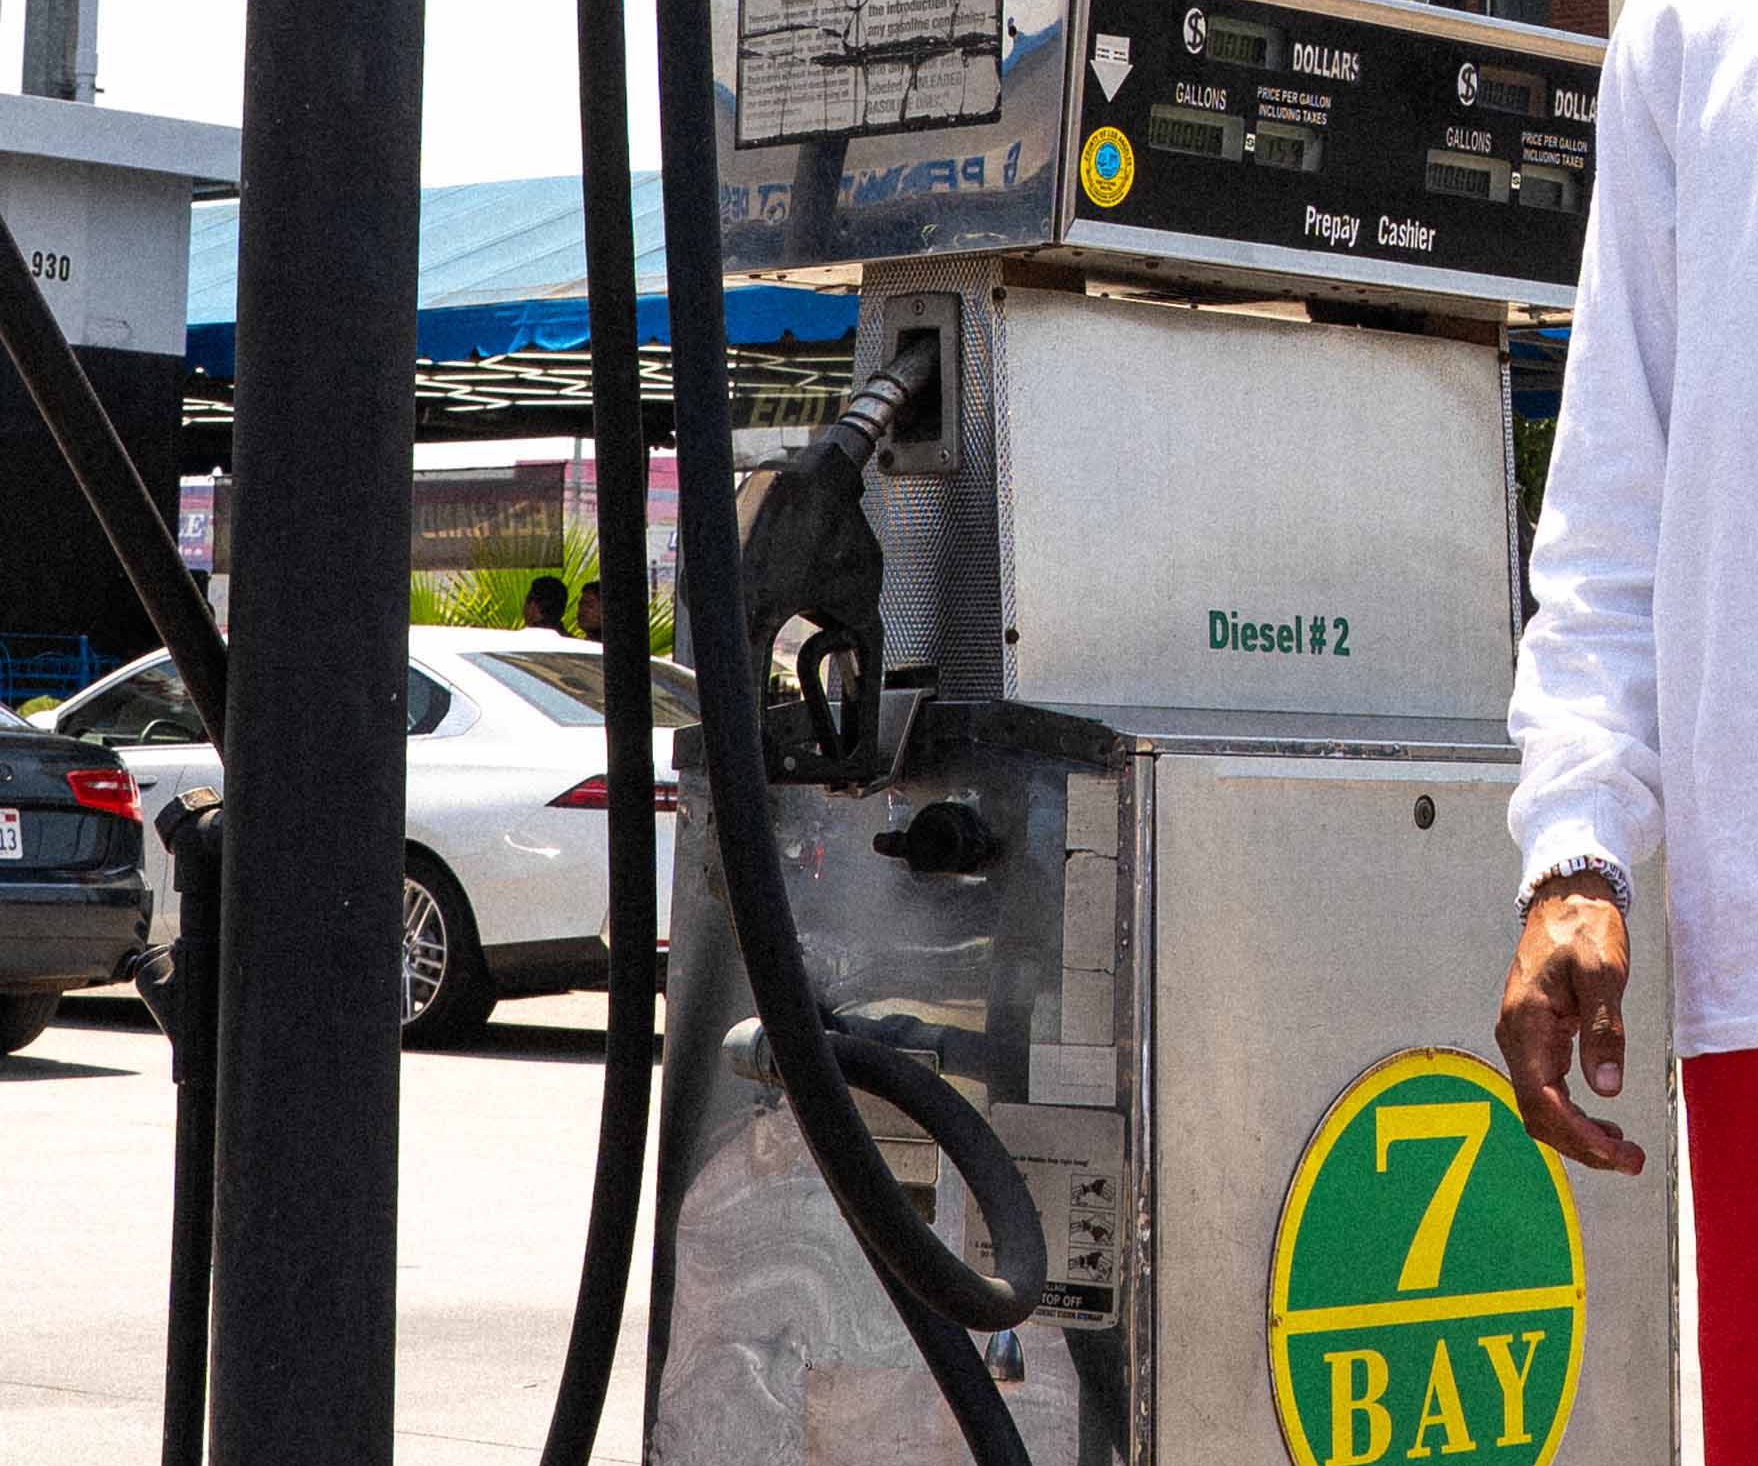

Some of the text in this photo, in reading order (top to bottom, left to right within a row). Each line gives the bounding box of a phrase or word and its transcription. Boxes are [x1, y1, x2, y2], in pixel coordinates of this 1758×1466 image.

[868, 4, 884, 17] the
[867, 24, 885, 38] any
[887, 18, 929, 36] gasoline
[1292, 42, 1360, 82] DOLLARS
[1175, 82, 1227, 111] GALLONS
[1257, 86, 1331, 109] PRICE PER GALLON
[1554, 89, 1598, 123] DOLLA
[1258, 103, 1328, 126] INCLUDING TAXES
[1446, 126, 1492, 153] GALLONS
[1521, 131, 1588, 153] PRICE PER GALLON
[1522, 148, 1585, 169] INCLUDING TAXES
[1304, 205, 1436, 252] Prepay Cashier
[32, 251, 70, 281] 930
[1208, 610, 1303, 655] Diesel
[1375, 1101, 1491, 1292] 7
